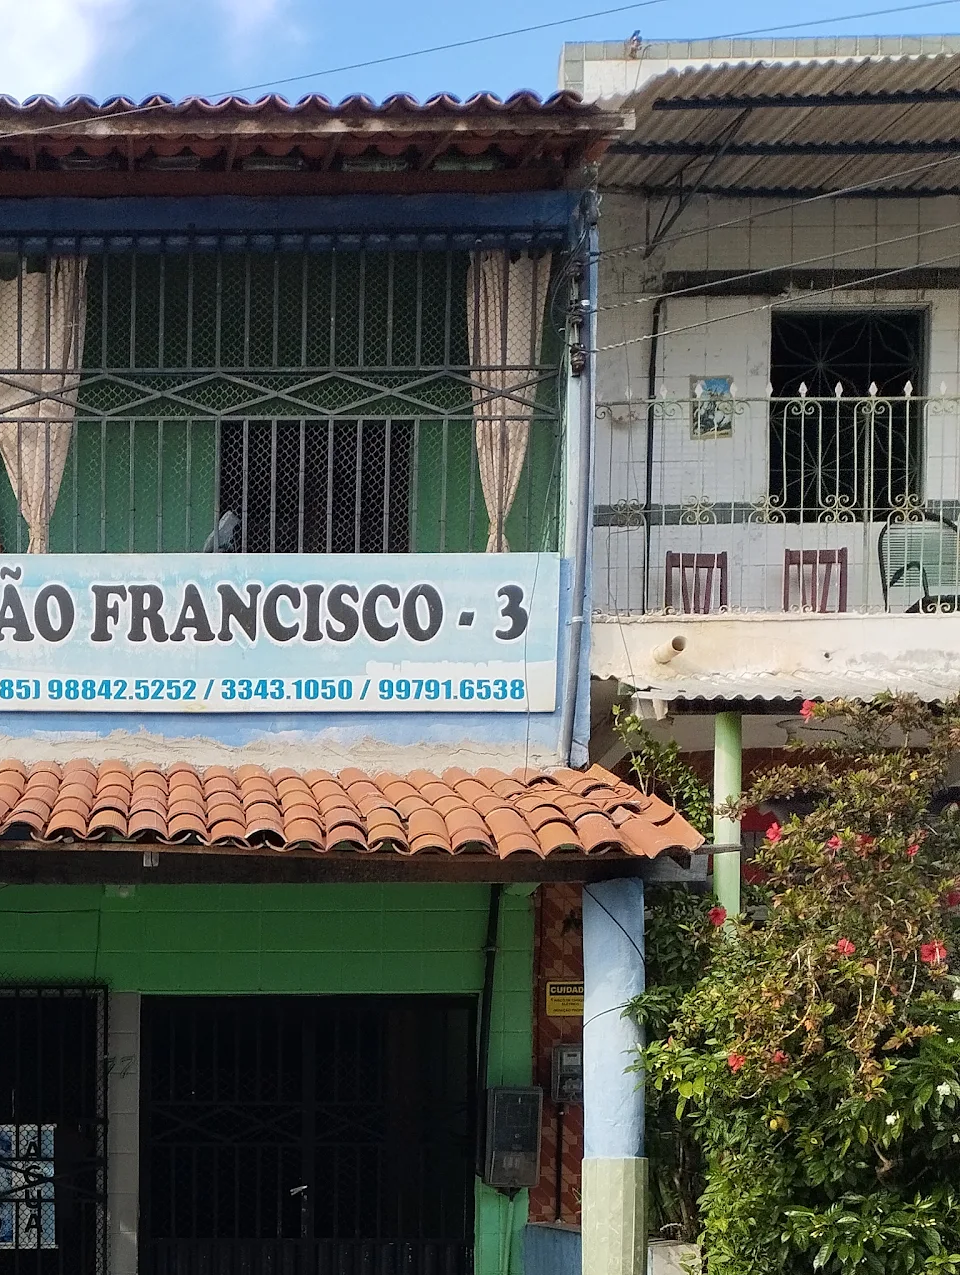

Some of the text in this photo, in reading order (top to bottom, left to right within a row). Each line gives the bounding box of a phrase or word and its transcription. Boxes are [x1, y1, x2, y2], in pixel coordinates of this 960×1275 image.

[90, 583, 444, 643] FRANCISCO
[494, 584, 529, 641] 3
[48, 679, 198, 700] 98842.5252
[221, 679, 353, 701] 3343.1050
[378, 679, 526, 701] 99791.6538
[550, 986, 584, 994] CUIDAD
